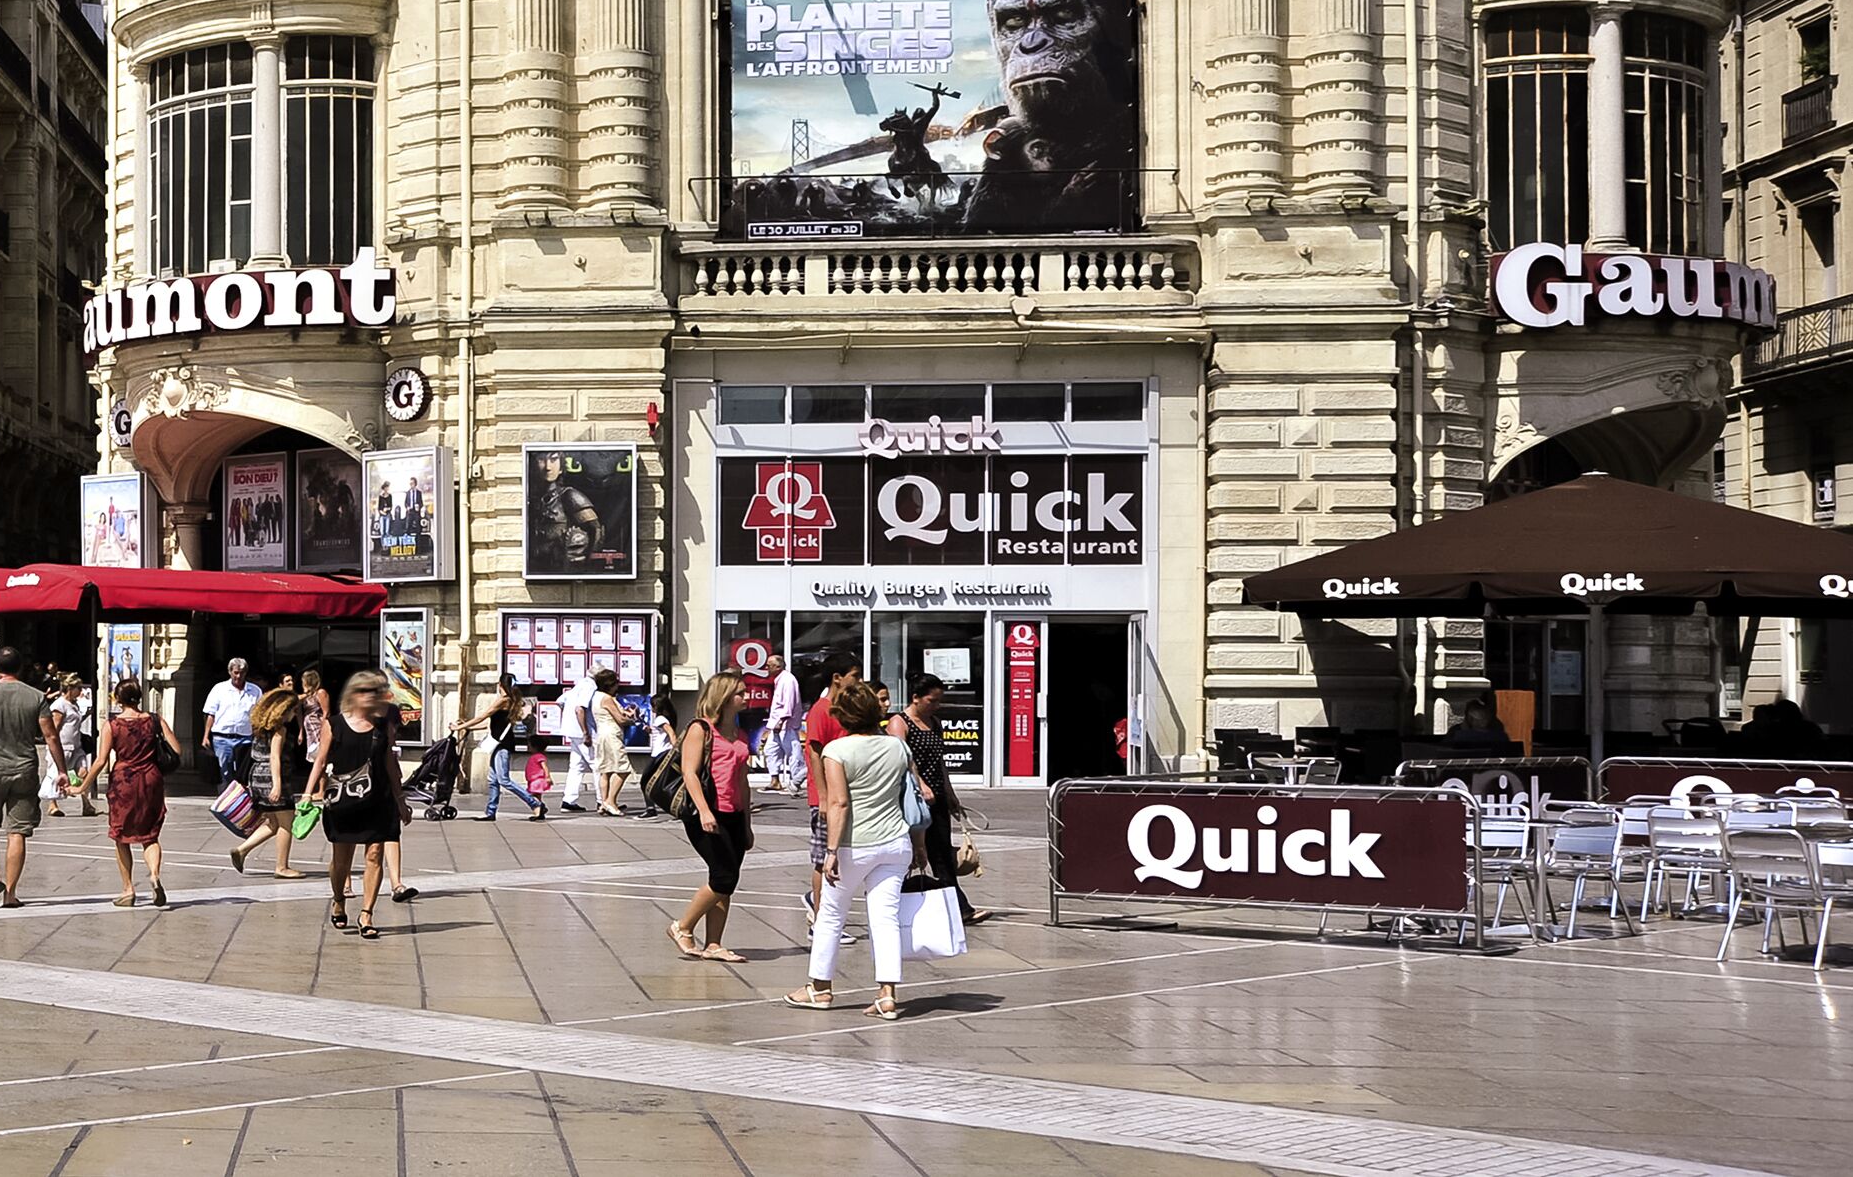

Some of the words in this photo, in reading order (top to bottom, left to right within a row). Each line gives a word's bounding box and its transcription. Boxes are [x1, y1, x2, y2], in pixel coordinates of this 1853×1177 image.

[746, 41, 775, 52] DES
[774, 29, 955, 63] SINGES
[745, 58, 953, 78] L'AFFRONTEMENT
[752, 226, 766, 235] LE
[768, 226, 784, 235] 30
[785, 225, 829, 235] JUILLET
[843, 225, 858, 234] 3D
[859, 414, 1003, 460] Quick
[764, 472, 818, 521] Q
[877, 470, 1138, 546] Quick
[760, 533, 820, 550] Quick
[997, 538, 1139, 555] Restaurant
[810, 579, 875, 598] Quality
[883, 580, 943, 598] Burger
[951, 579, 1050, 595] Restaurant
[1321, 575, 1400, 601] Quick
[1559, 572, 1645, 596] Quick
[1012, 624, 1035, 646] Q
[735, 641, 770, 678] Q
[940, 719, 979, 730] PLACE
[942, 729, 979, 740] INÉMA
[1126, 803, 1386, 890] Quick
